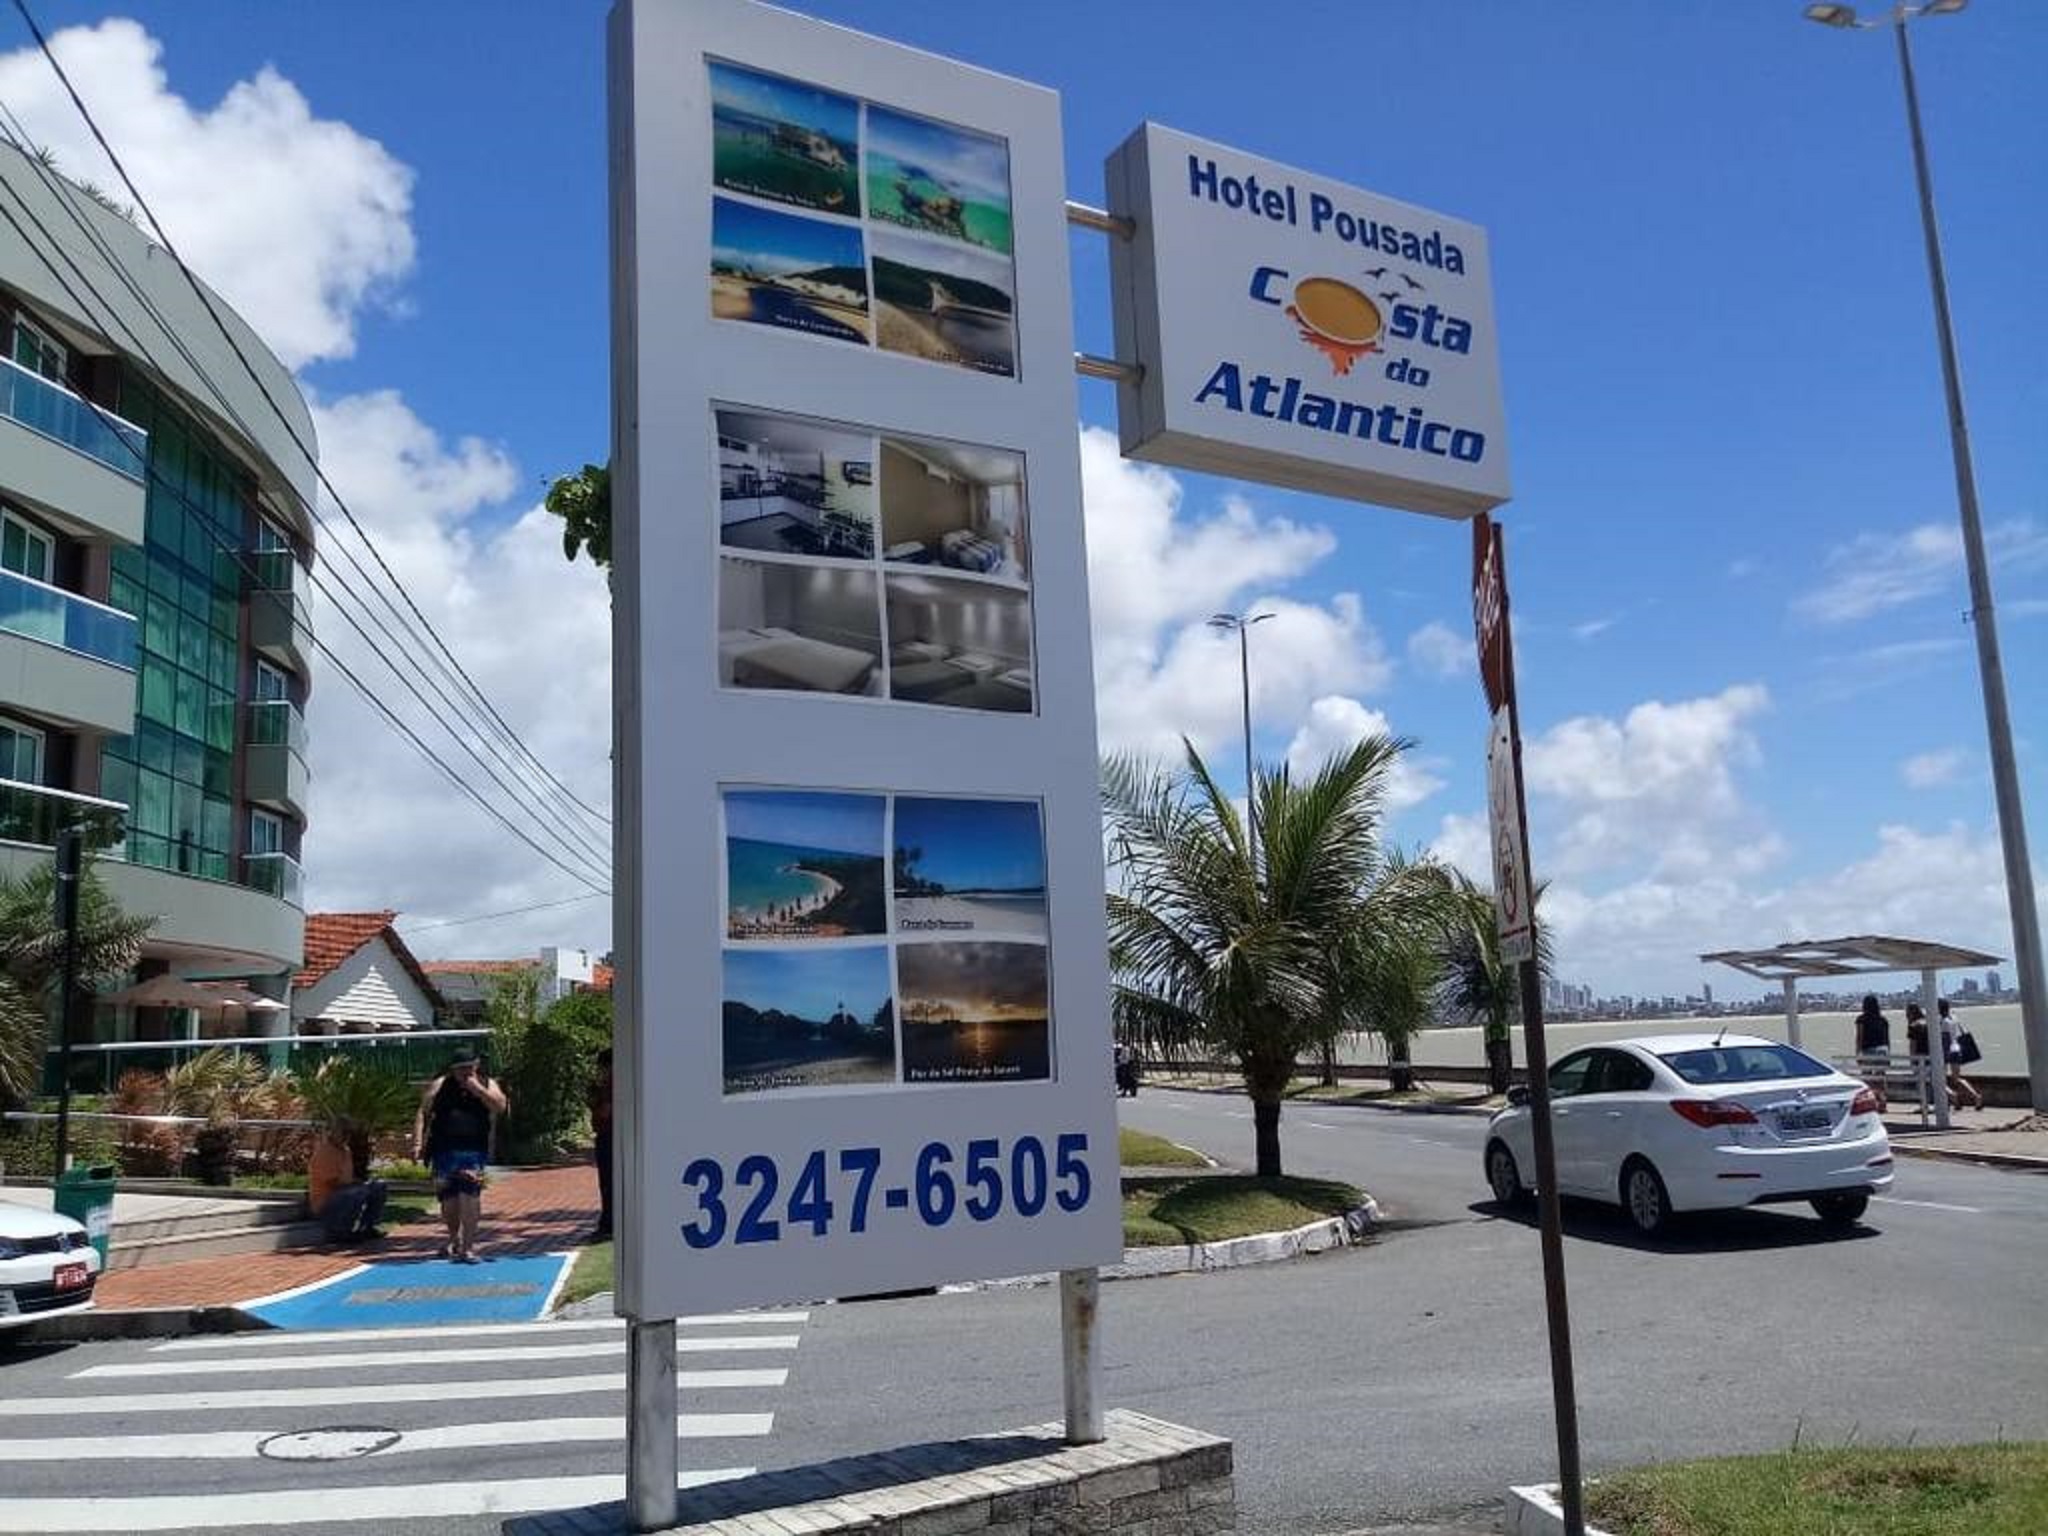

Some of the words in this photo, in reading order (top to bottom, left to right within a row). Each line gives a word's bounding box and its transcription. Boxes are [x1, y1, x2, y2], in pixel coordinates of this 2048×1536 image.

[1188, 155, 1297, 226] Hotel
[1311, 192, 1464, 276] Pousada
[1193, 362, 1487, 465] Atlantico
[1385, 358, 1431, 387] do
[681, 1132, 1092, 1249] 3247-6505
